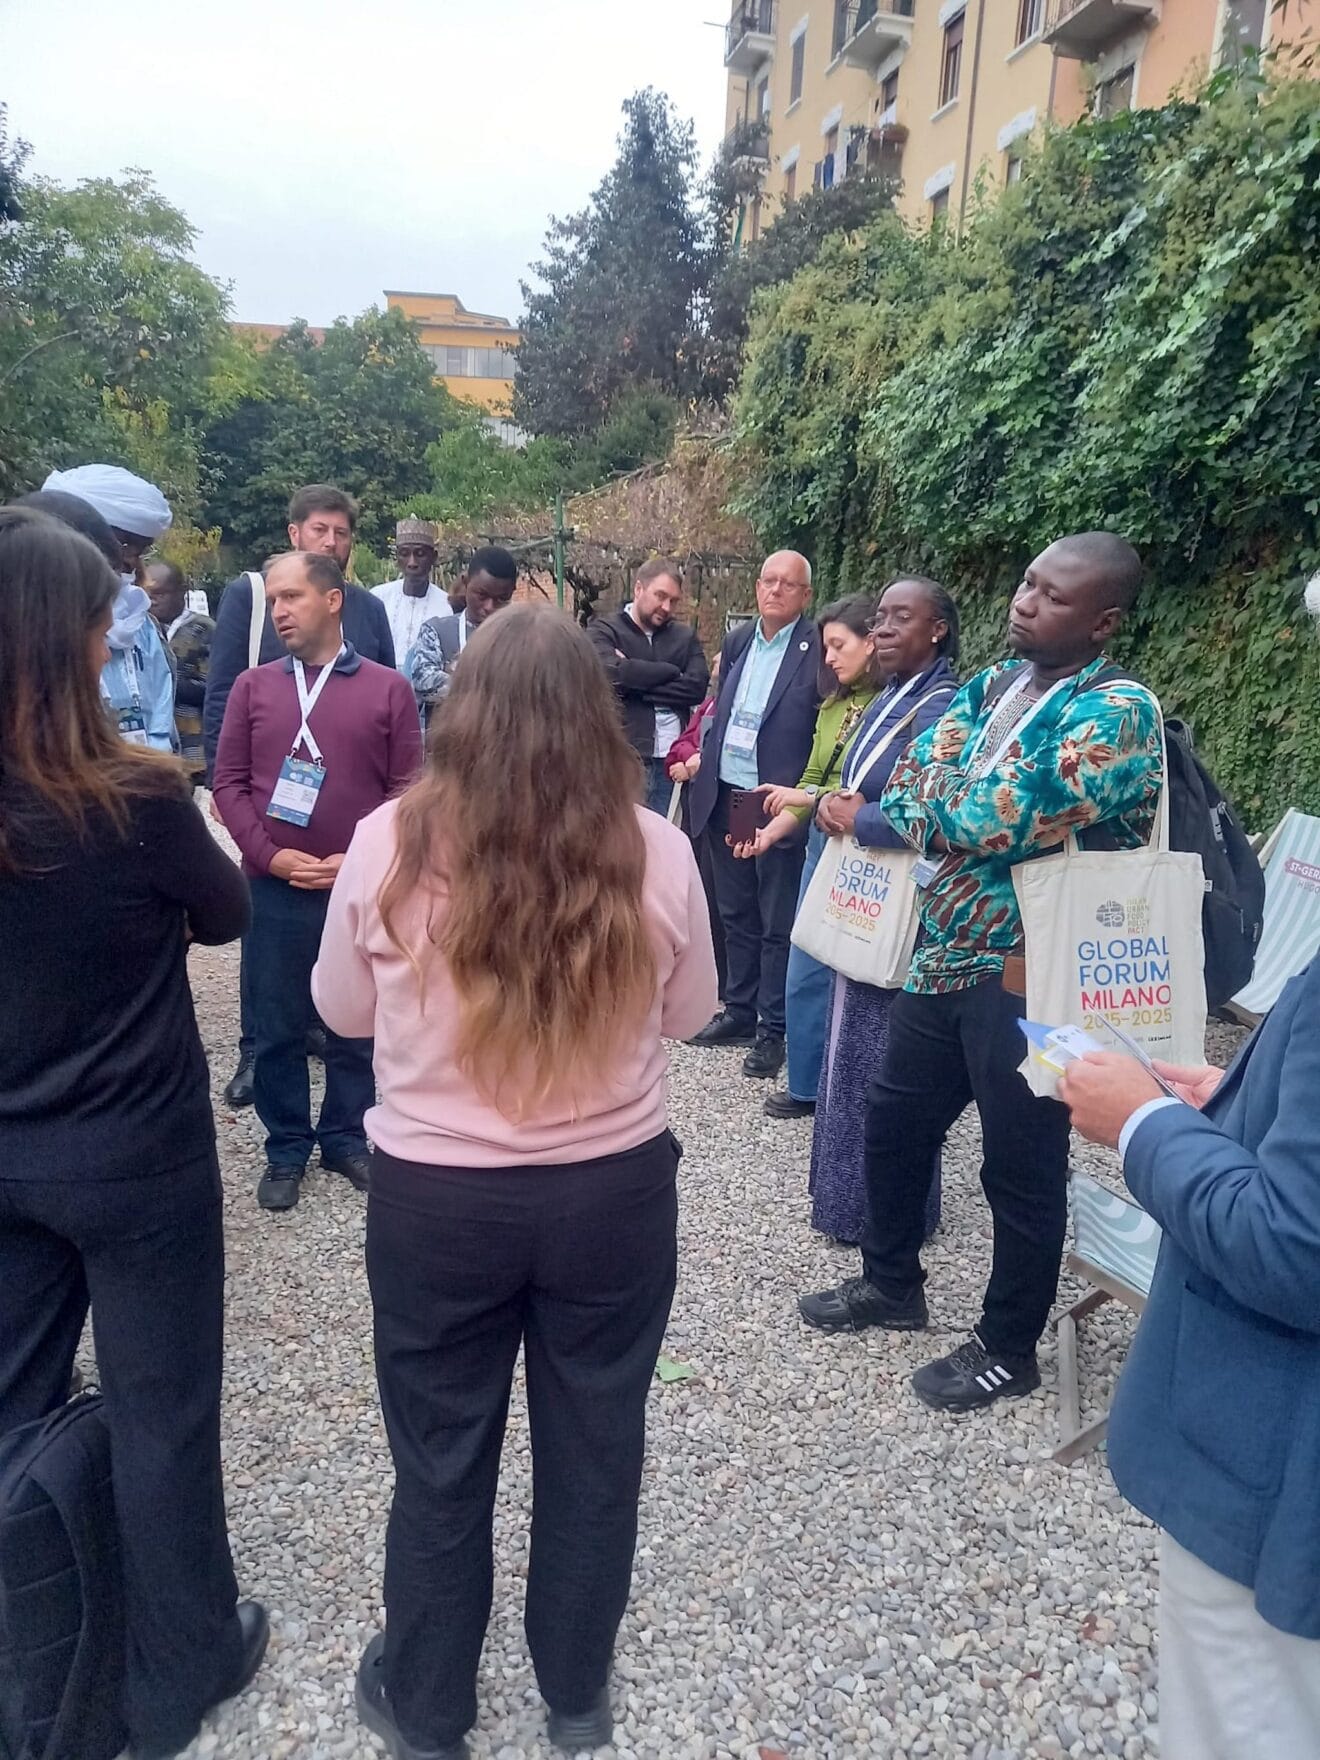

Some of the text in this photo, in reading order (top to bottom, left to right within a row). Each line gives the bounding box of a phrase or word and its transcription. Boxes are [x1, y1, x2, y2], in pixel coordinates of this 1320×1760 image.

[1078, 936, 1169, 961] GLOBAL
[1079, 960, 1170, 987] FORUM
[1081, 984, 1172, 1011] MILANO
